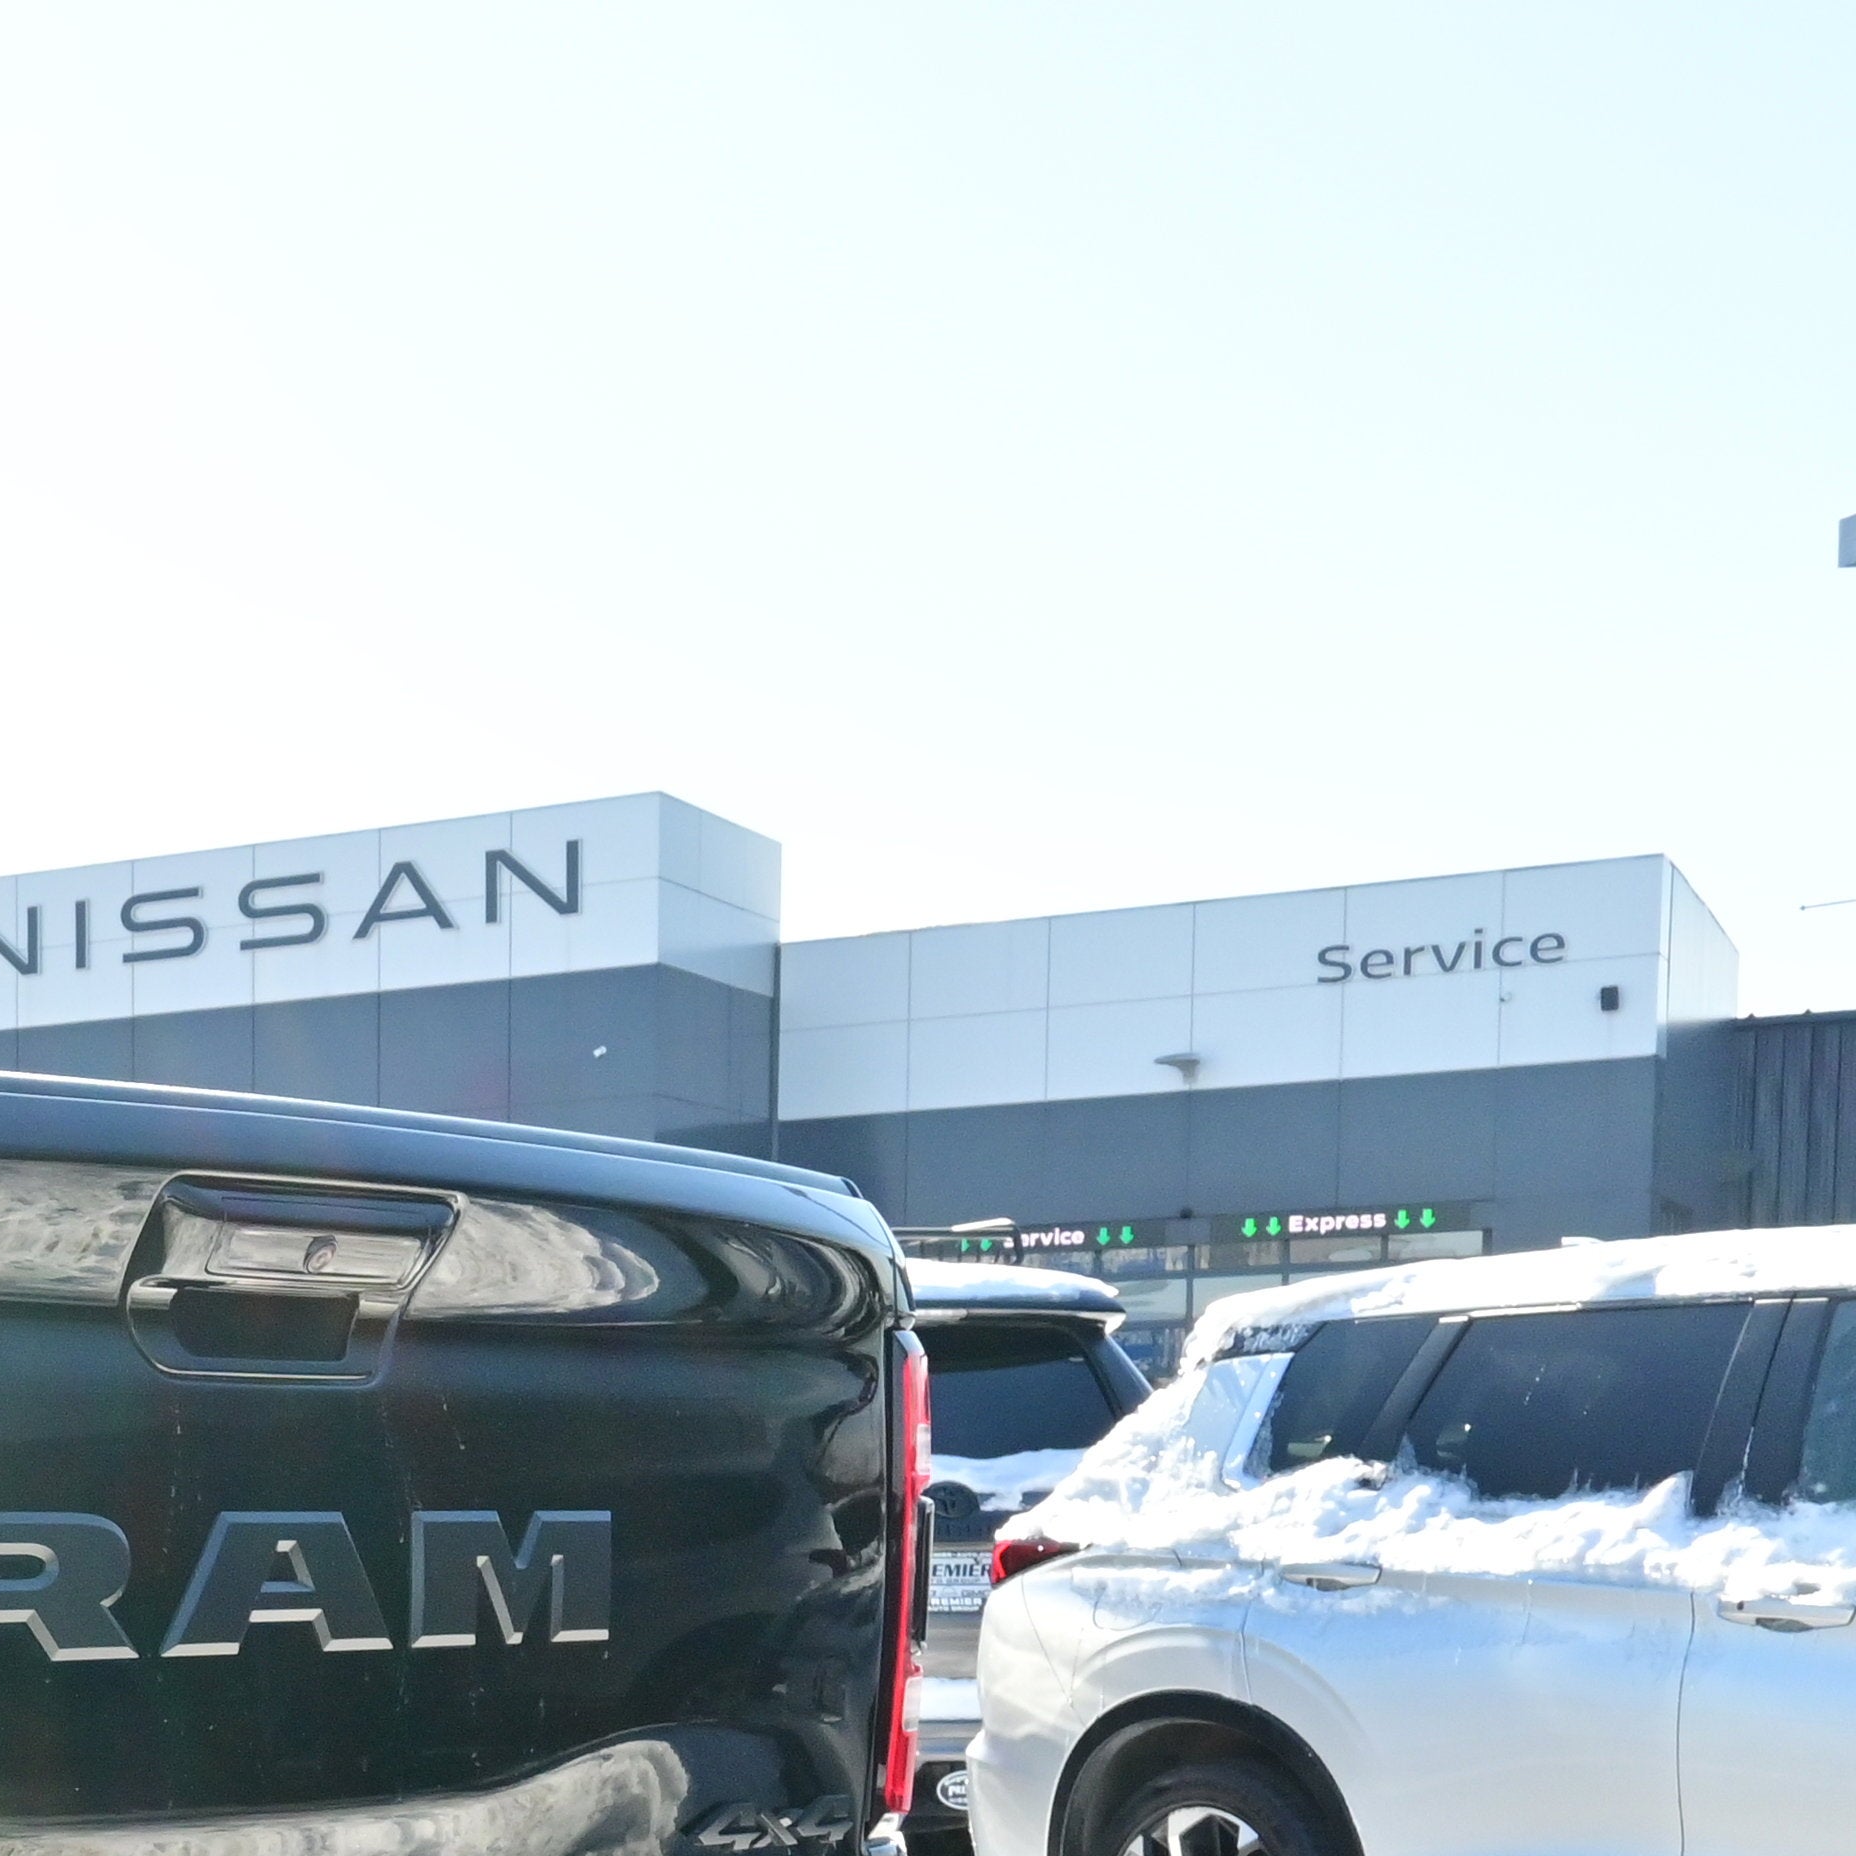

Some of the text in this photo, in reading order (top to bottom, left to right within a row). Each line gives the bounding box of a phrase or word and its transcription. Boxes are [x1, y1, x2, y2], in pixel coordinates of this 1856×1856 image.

[1316, 928, 1567, 983] Service
[1288, 1213, 1387, 1235] Express
[932, 1563, 992, 1577] EMIER
